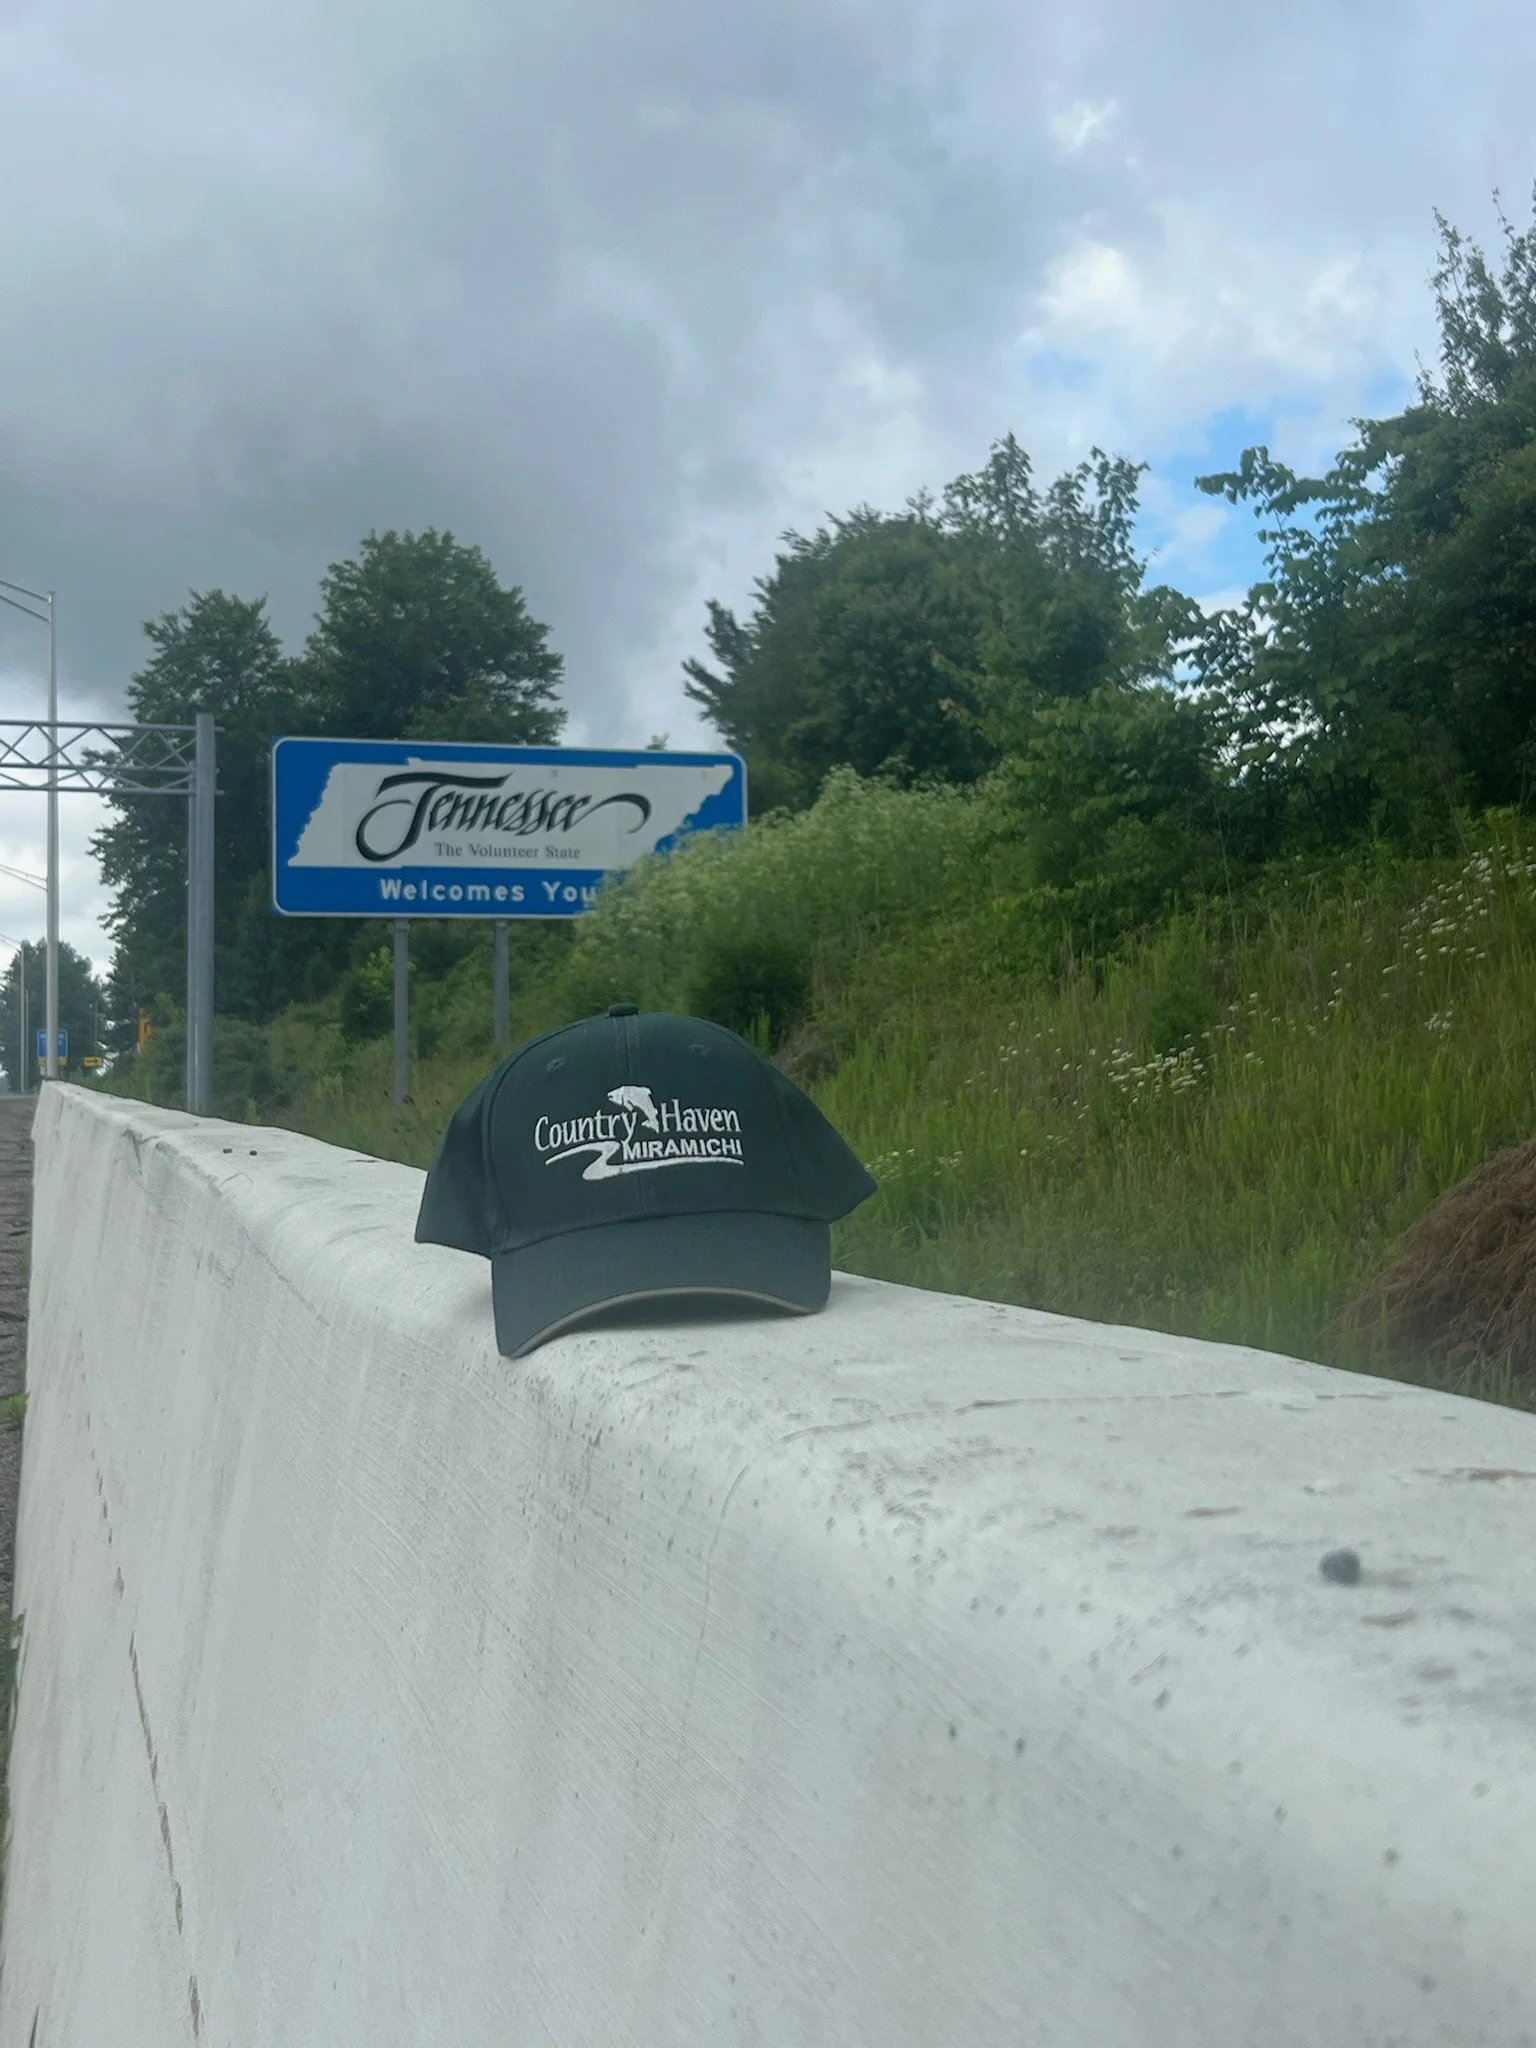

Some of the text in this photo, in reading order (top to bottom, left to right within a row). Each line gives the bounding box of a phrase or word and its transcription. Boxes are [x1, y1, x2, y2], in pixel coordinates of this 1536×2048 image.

[356, 771, 652, 863] Tennessee
[435, 842, 581, 860] The Volunteer State
[380, 878, 597, 902] Welcomes You
[534, 1099, 742, 1152] Country Haven
[622, 1138, 743, 1161] MIRAMICHI
